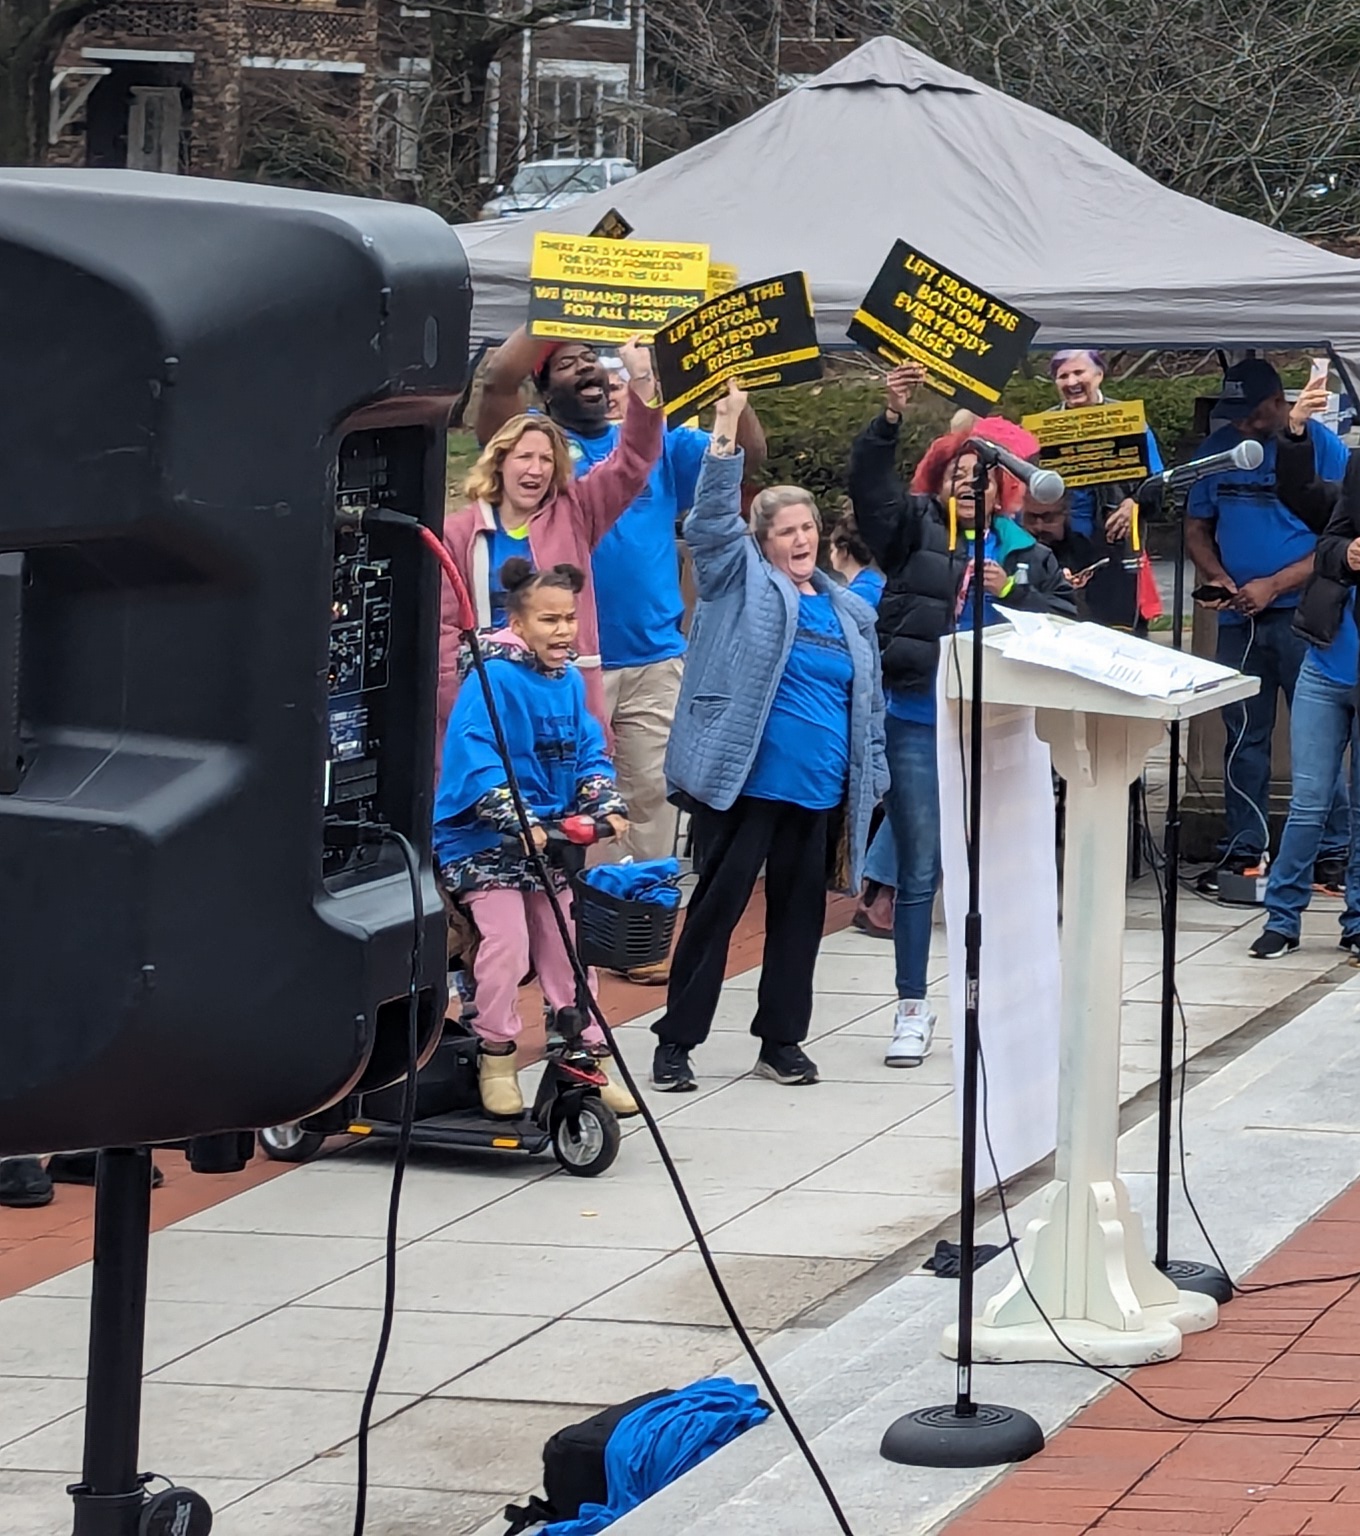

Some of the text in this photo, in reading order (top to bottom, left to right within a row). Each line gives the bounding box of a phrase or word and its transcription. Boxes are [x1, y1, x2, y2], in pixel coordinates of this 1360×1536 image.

[558, 255, 581, 264] FOR
[650, 272, 673, 282] U.S.
[534, 286, 700, 309] WE DEMAND HOUSING
[904, 253, 1020, 332] LIFT FROM THE
[916, 284, 987, 335] BOTTOM
[563, 303, 669, 322] FOR ALL NOW
[669, 319, 696, 344] LIFT
[699, 292, 747, 325] FROM
[750, 281, 786, 302] THE
[691, 305, 762, 347] BOTTOM
[893, 291, 994, 357] EVERYBODY
[681, 317, 780, 371] EVERYBODY
[707, 342, 754, 373] RISES
[907, 322, 956, 359] RISES
